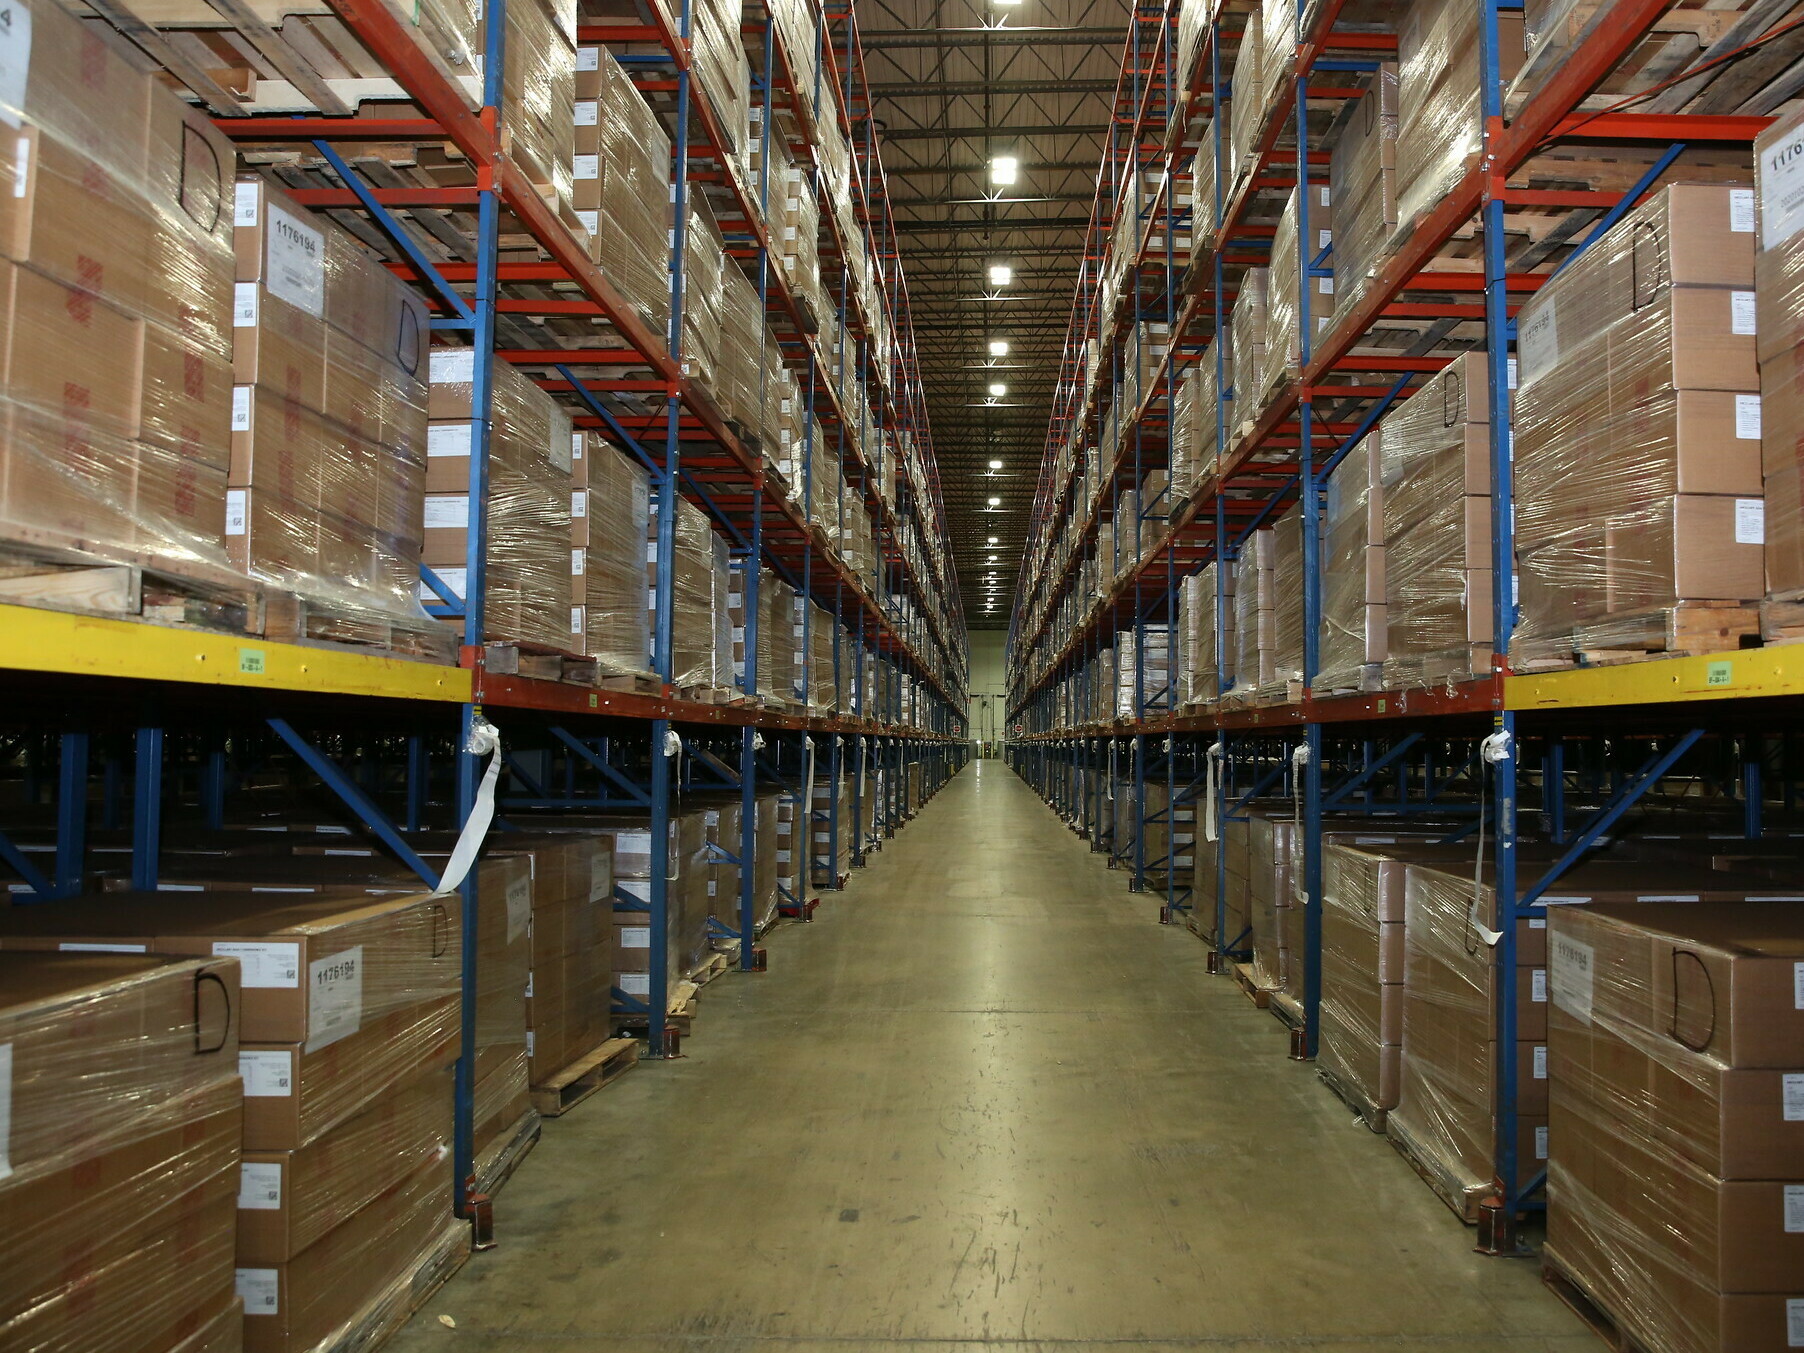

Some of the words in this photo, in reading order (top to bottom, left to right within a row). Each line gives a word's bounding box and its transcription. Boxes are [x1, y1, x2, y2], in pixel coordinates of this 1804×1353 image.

[177, 120, 222, 233] D
[1771, 138, 1804, 171] 1176
[276, 219, 316, 252] 1176194
[1631, 220, 1661, 312] D
[1444, 370, 1460, 429] D
[432, 904, 448, 958] D
[1558, 941, 1588, 965] 1176194
[317, 959, 355, 985] 1176194
[1668, 946, 1716, 1053] D
[194, 967, 230, 1056] D
